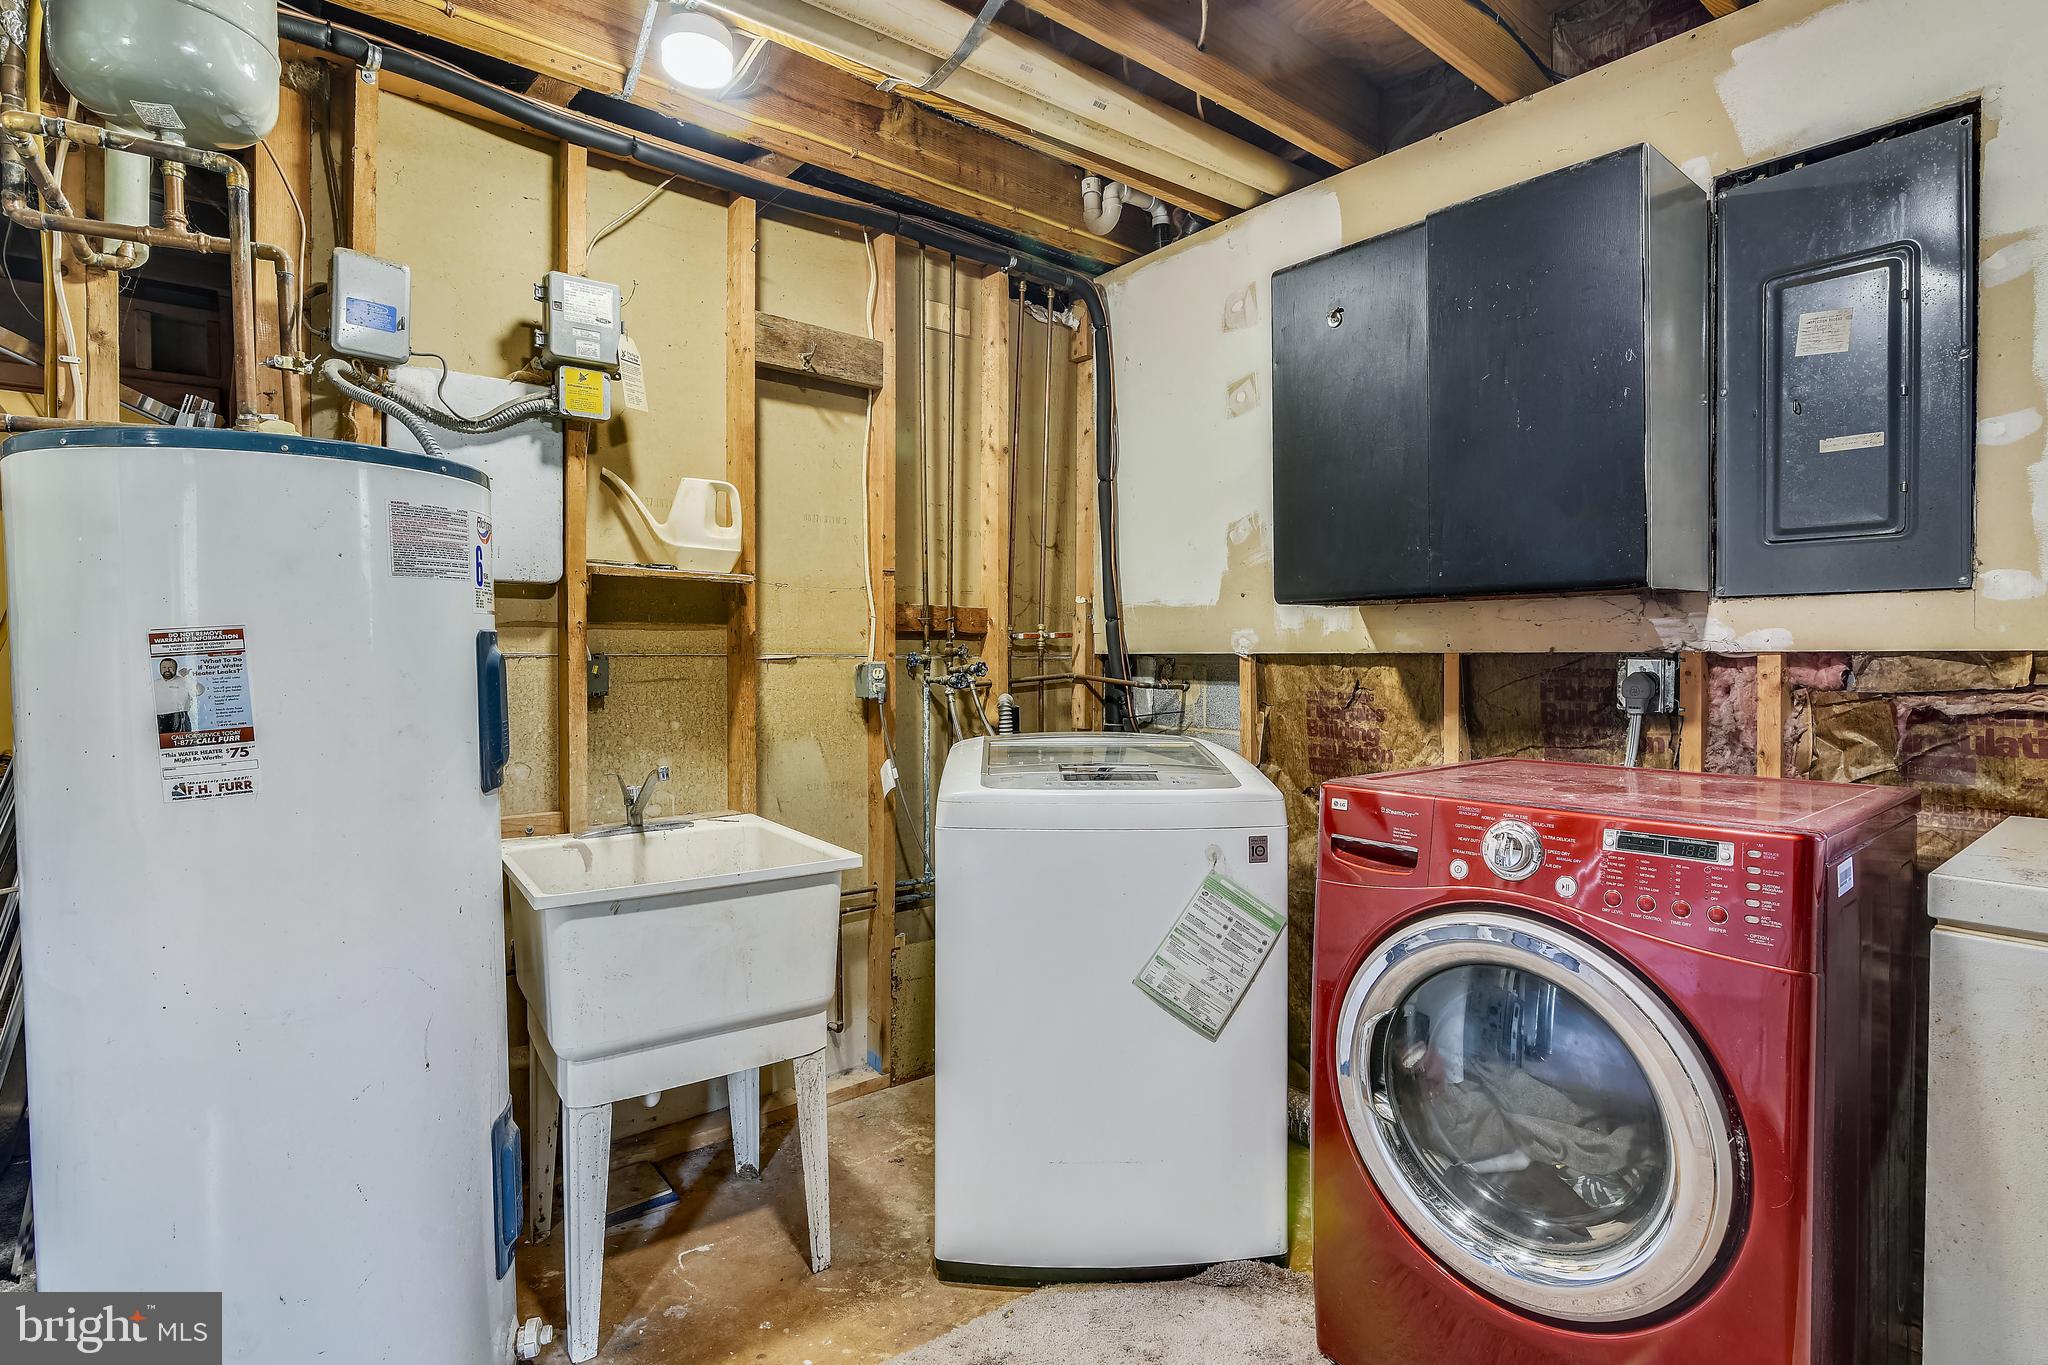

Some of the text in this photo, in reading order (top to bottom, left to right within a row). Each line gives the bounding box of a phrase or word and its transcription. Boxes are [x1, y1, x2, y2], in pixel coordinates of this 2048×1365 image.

[187, 780, 253, 795] F.H. FURR
[1251, 846, 1265, 857] 10
